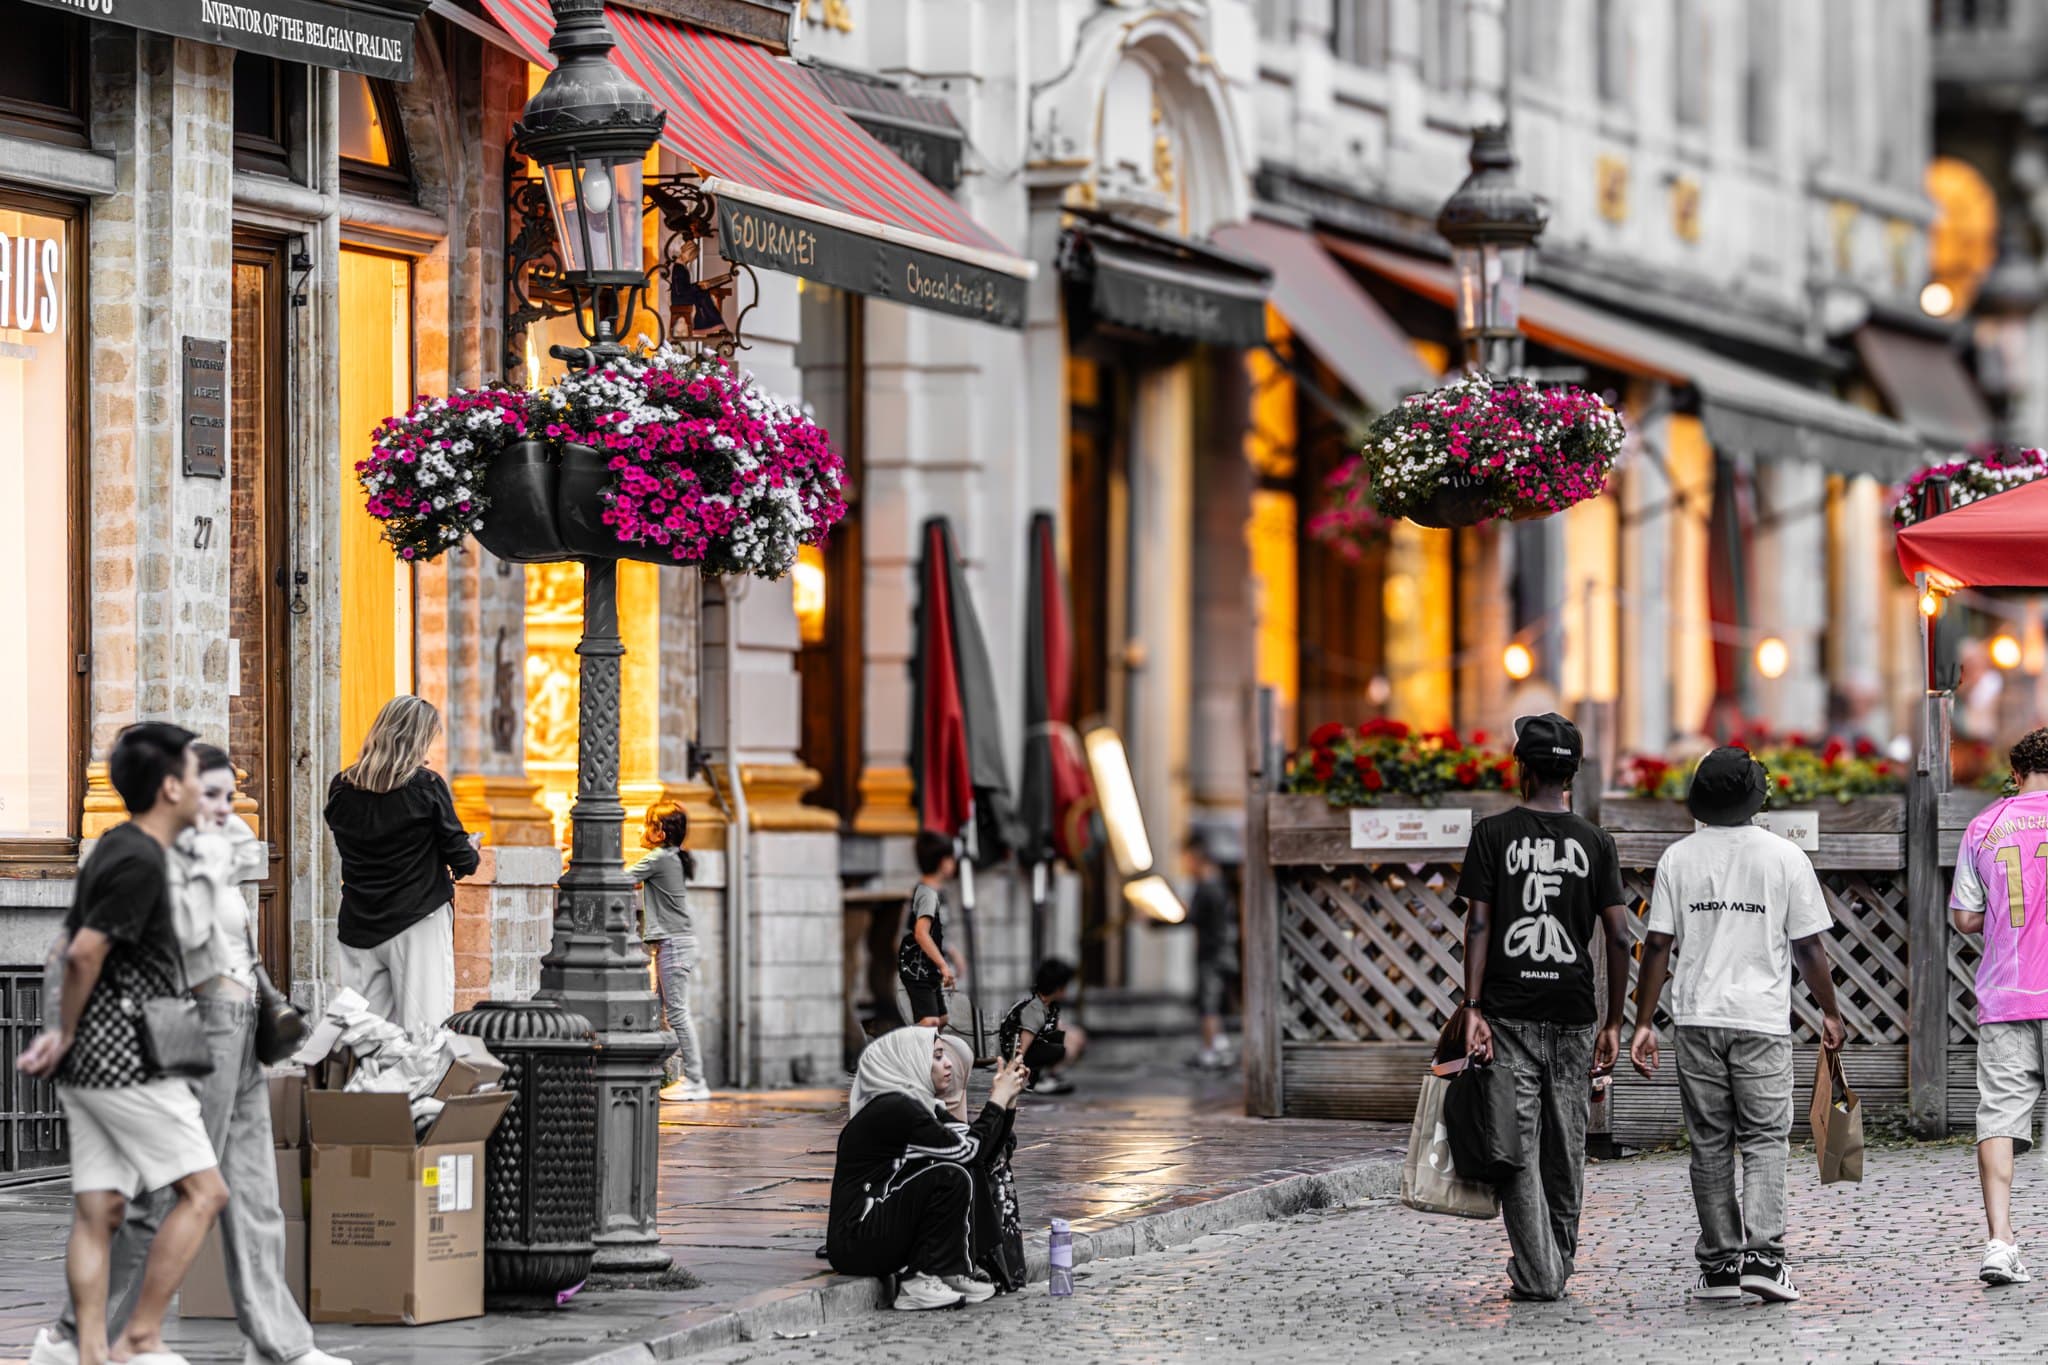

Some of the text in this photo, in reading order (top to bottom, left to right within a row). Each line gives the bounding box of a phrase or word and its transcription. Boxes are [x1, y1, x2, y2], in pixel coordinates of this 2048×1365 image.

[202, 0, 403, 63] INVENTOR OF THE BELGIAN PRALINE
[194, 515, 213, 550] 27
[1981, 815, 2048, 851] TOOMUCH
[1506, 836, 1590, 878] CHILD
[1522, 872, 1563, 912] OF
[1689, 900, 1766, 914] NEW YORK
[1504, 913, 1577, 963] GOD
